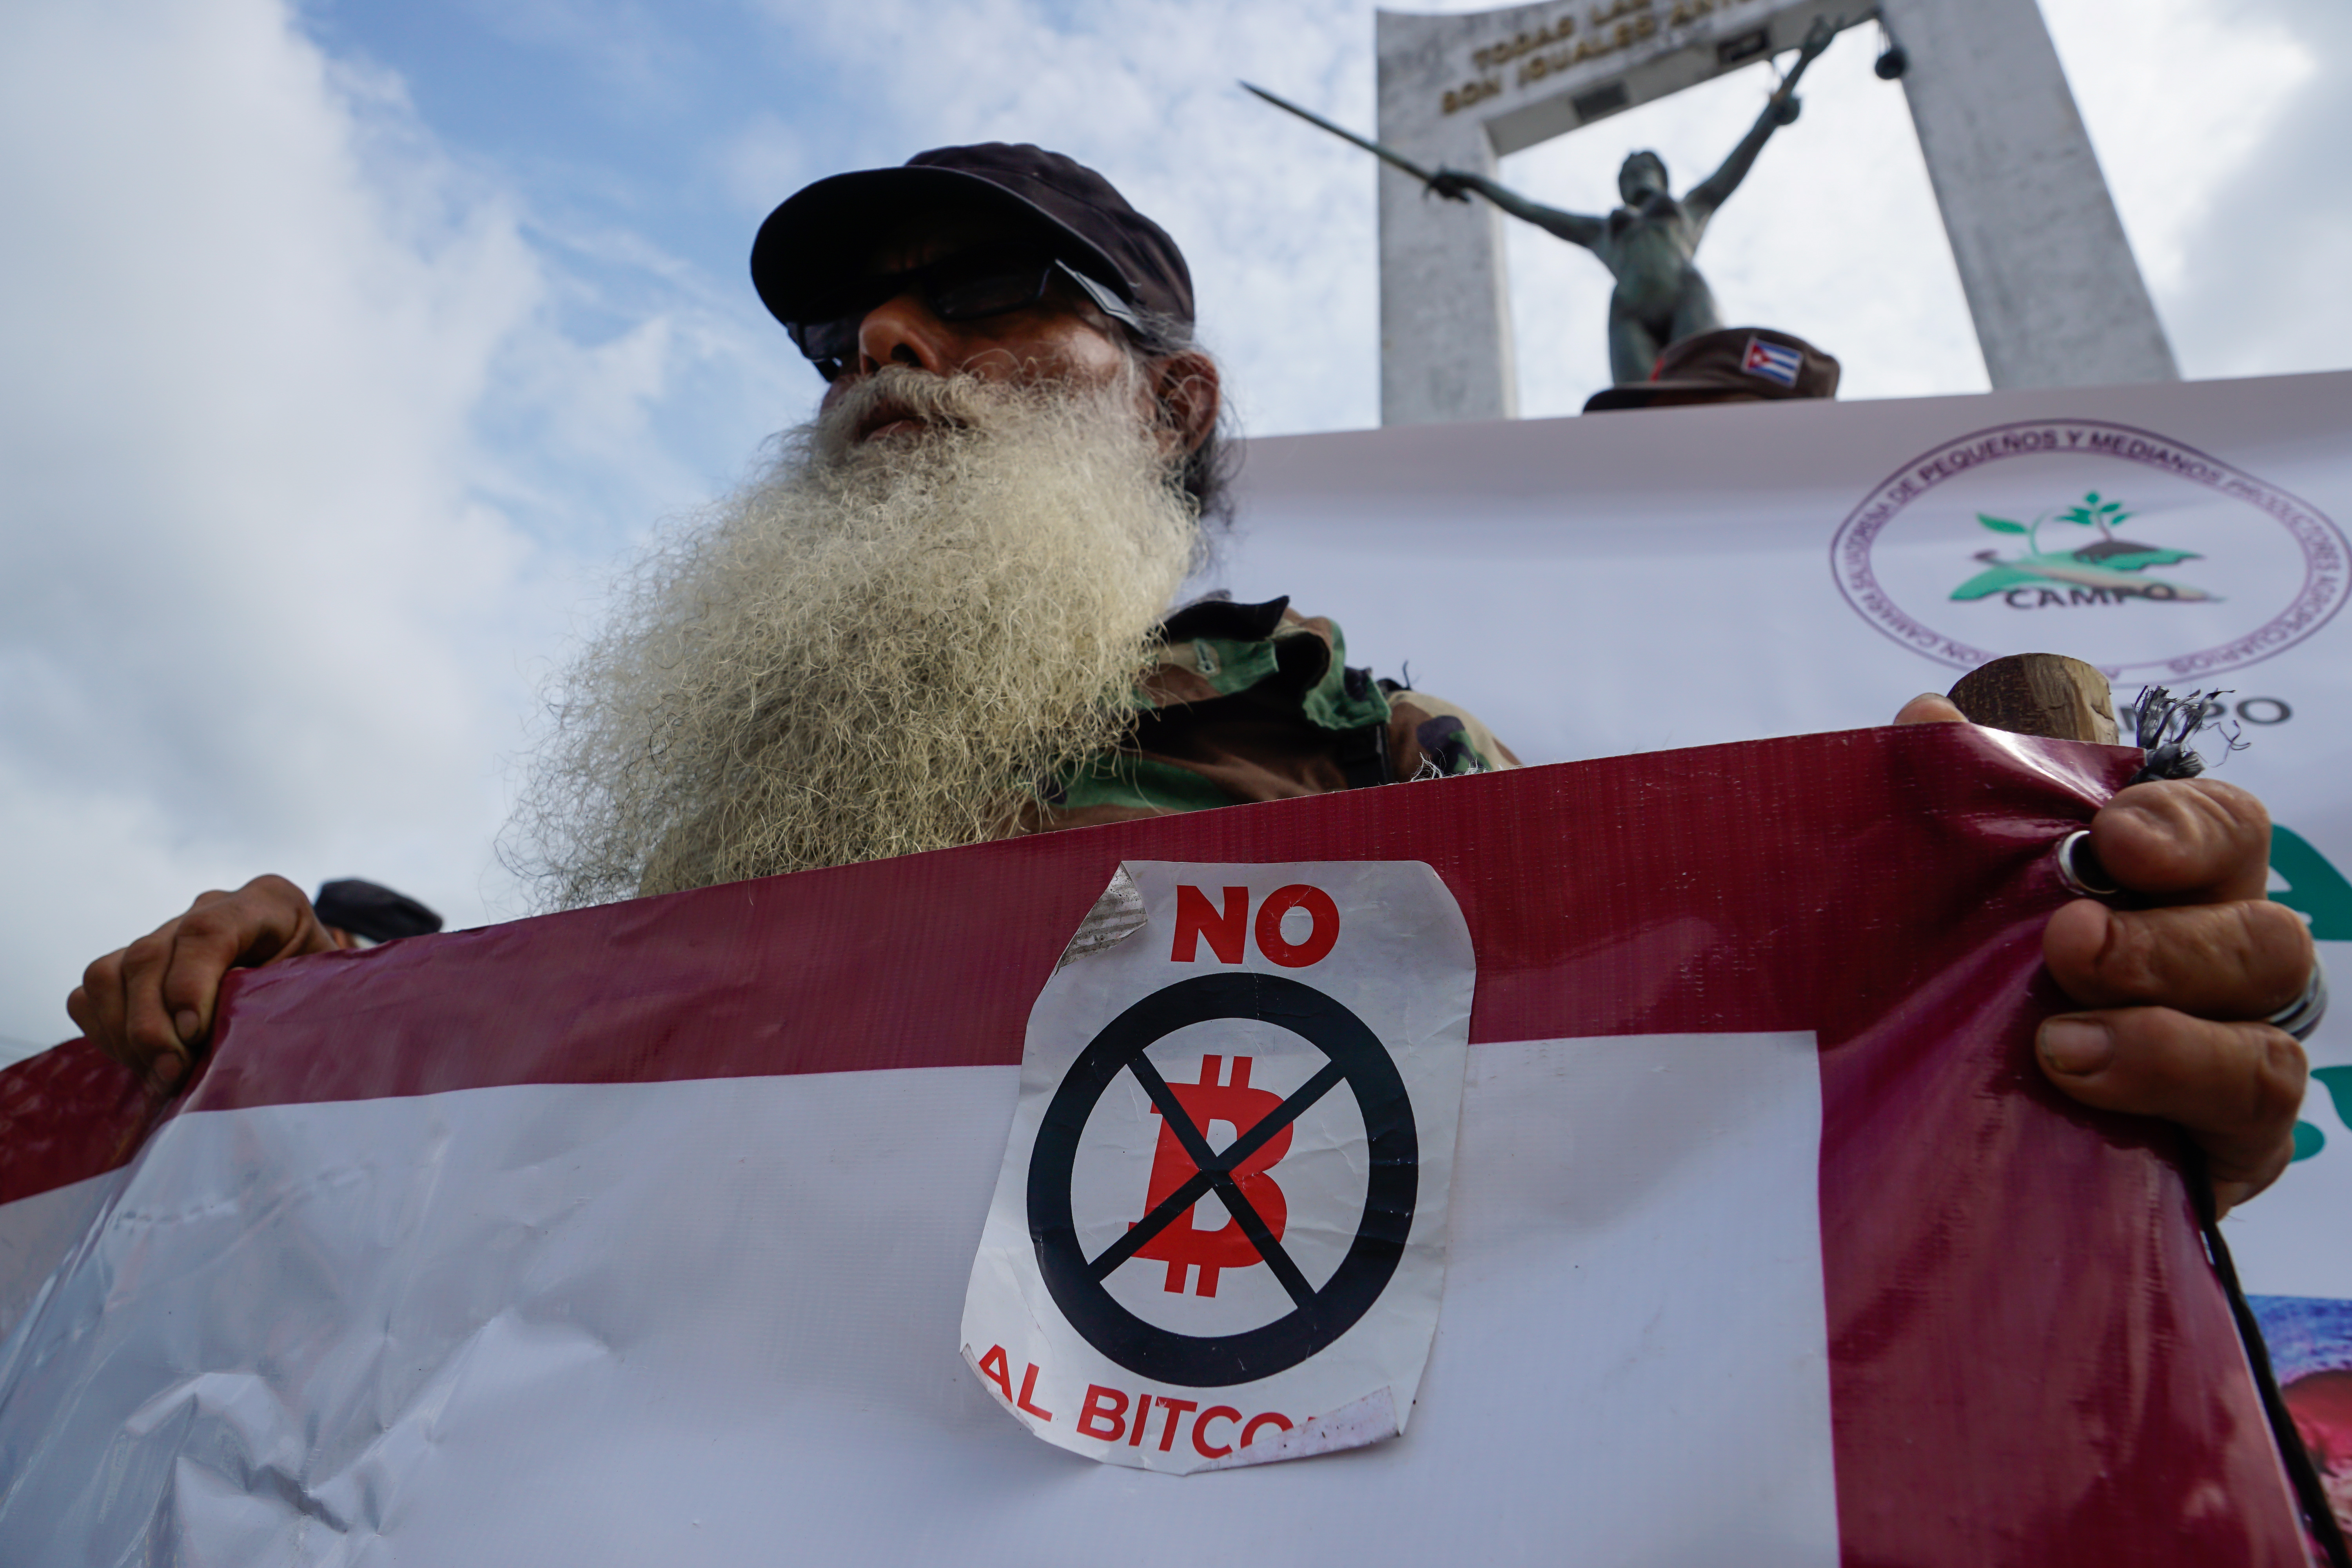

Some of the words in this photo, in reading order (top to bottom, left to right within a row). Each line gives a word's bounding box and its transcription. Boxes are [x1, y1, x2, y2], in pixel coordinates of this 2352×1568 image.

[1887, 478, 1922, 505] DE
[2067, 430, 2082, 448] Y
[2005, 583, 2178, 609] CAMPO
[1171, 884, 1340, 968] NO
[978, 1344, 1053, 1423] AL
[1076, 1383, 1317, 1459] BITCO
